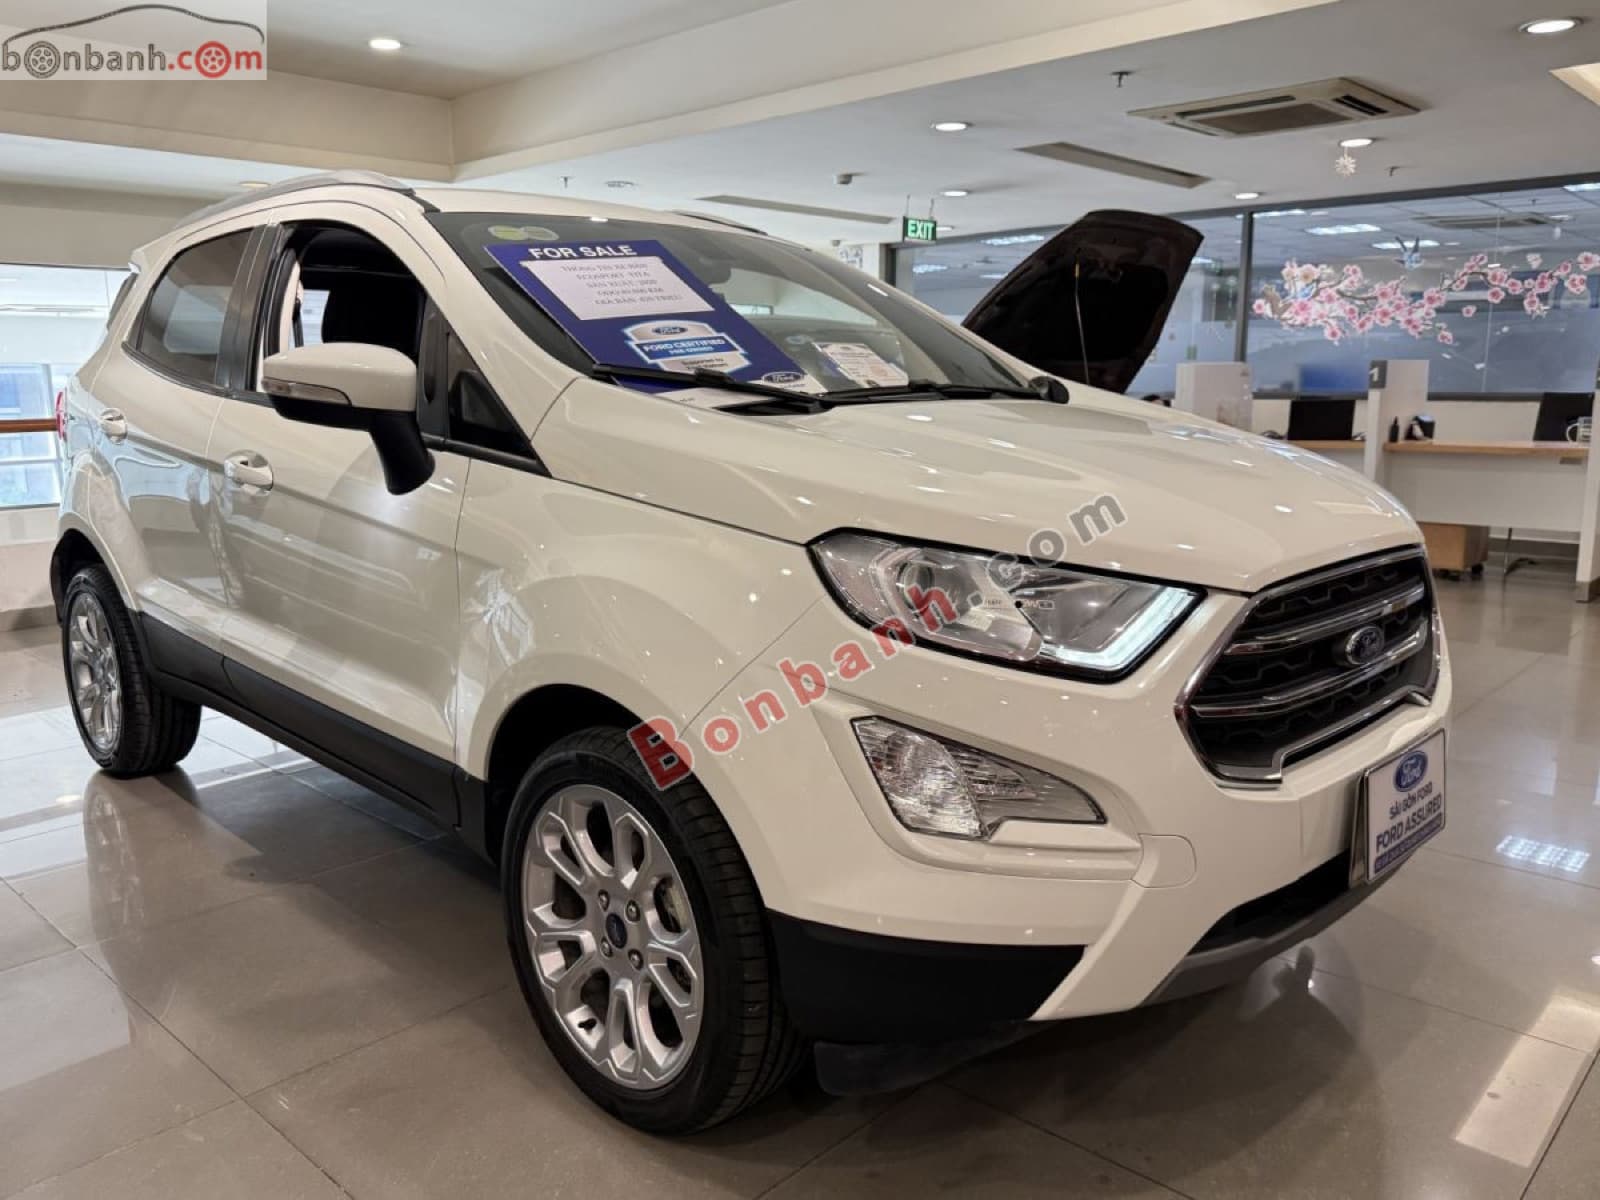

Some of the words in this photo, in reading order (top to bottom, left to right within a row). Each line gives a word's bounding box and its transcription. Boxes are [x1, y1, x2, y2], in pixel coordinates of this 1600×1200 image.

[907, 219, 935, 240] EXIT
[528, 247, 578, 259] FOR
[579, 245, 637, 257] SALE
[642, 343, 673, 352] FORD
[673, 339, 726, 349] CERTIFIED
[1369, 367, 1379, 381] 1
[1376, 822, 1403, 853] FORD
[1405, 792, 1442, 834] ASSURED
